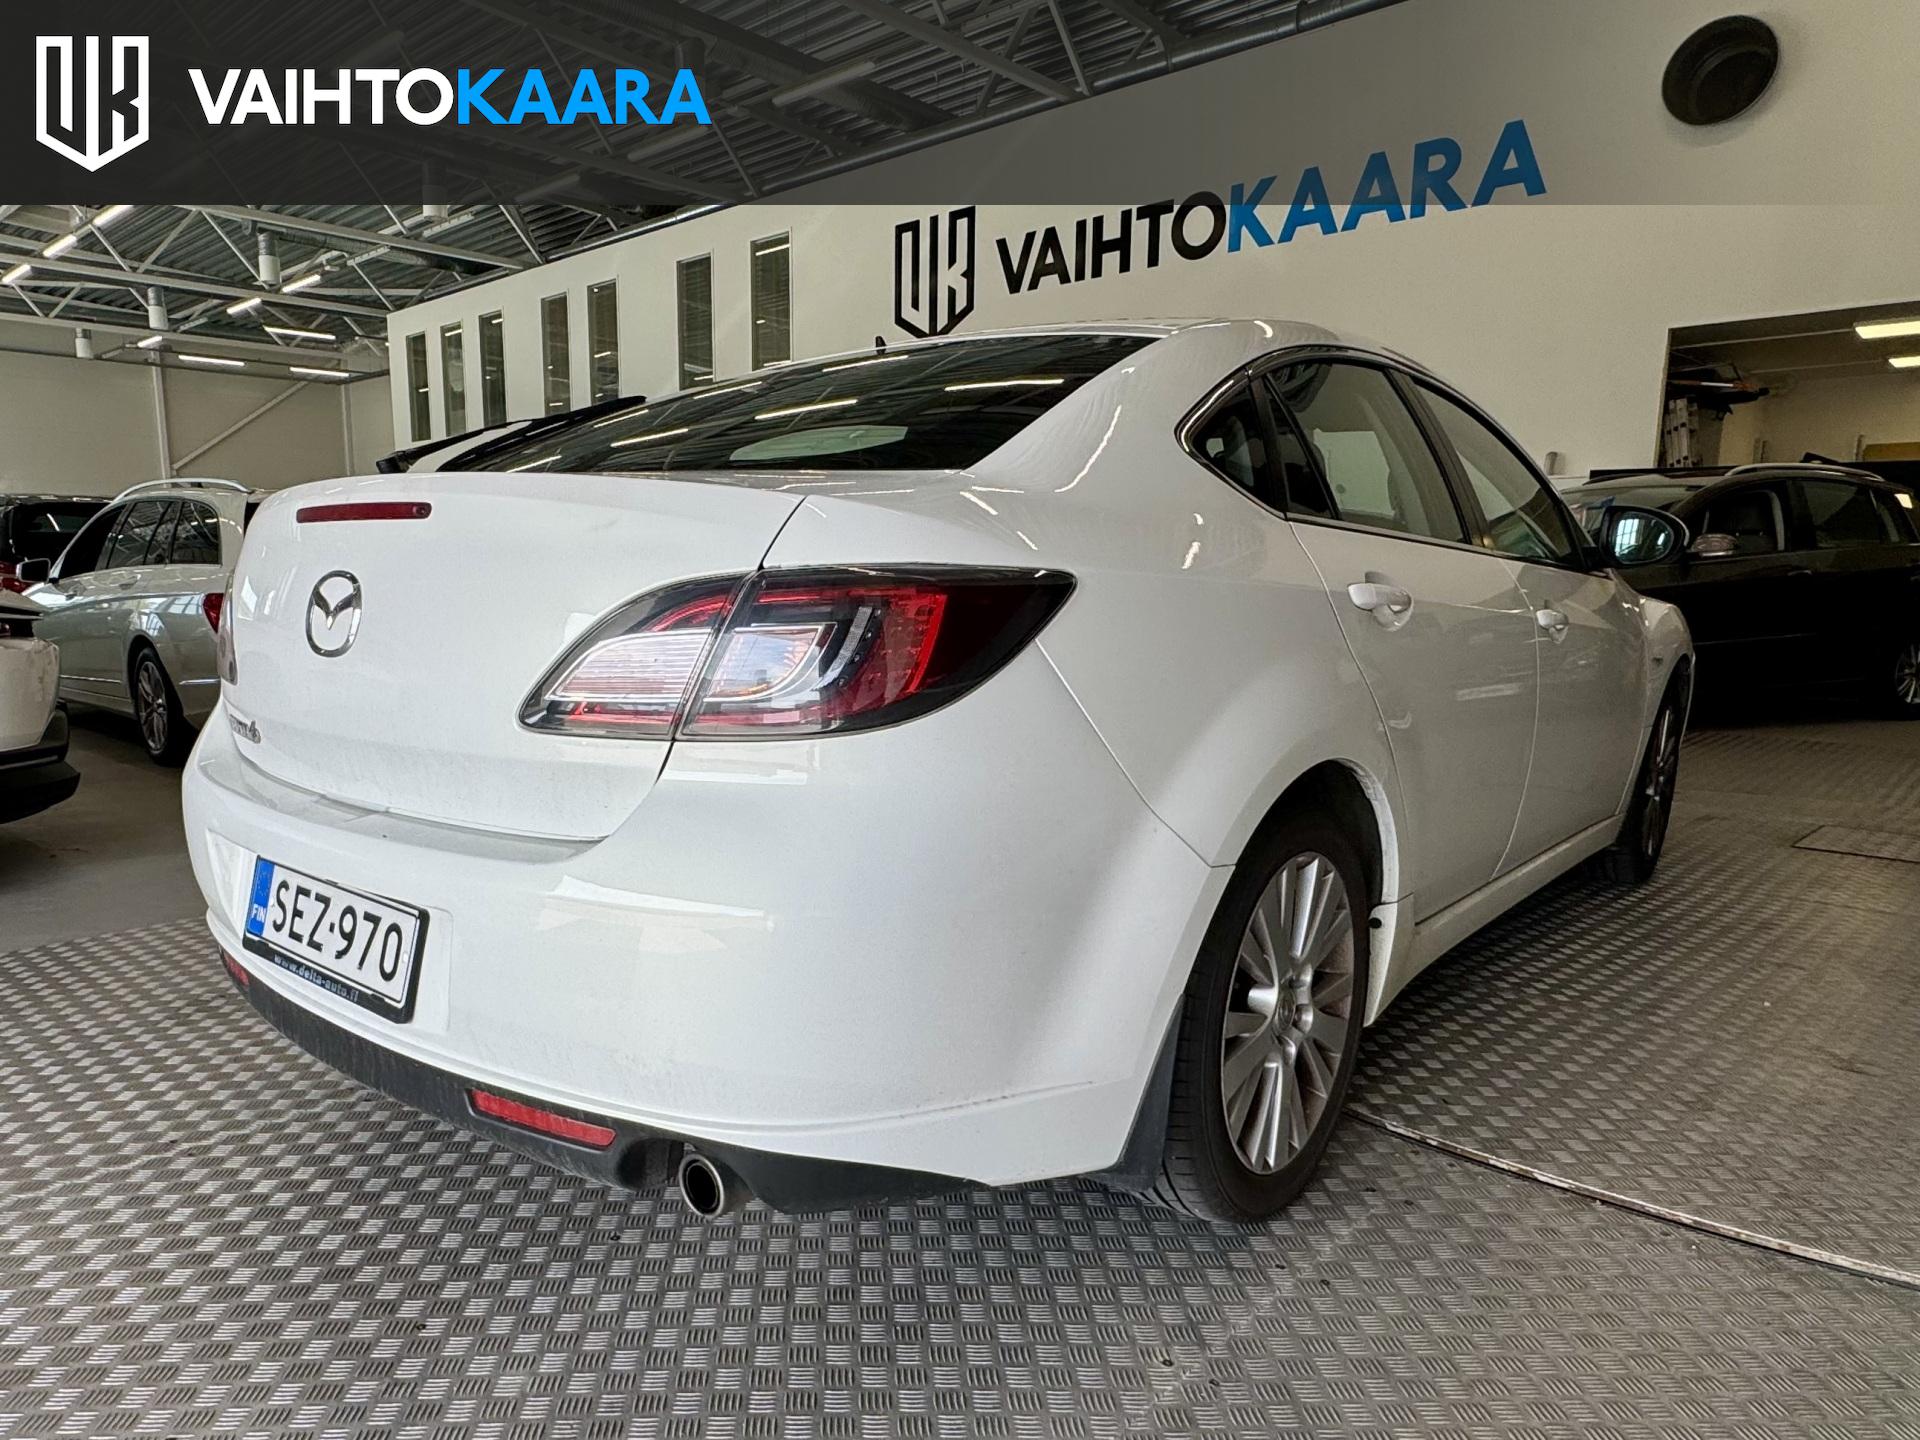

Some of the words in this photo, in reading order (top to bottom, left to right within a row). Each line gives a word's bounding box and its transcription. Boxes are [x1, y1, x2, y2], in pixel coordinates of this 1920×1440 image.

[995, 119, 1547, 295] VAIHTOKAARA
[251, 903, 267, 924] FIN
[272, 879, 404, 983] SEZ-970
